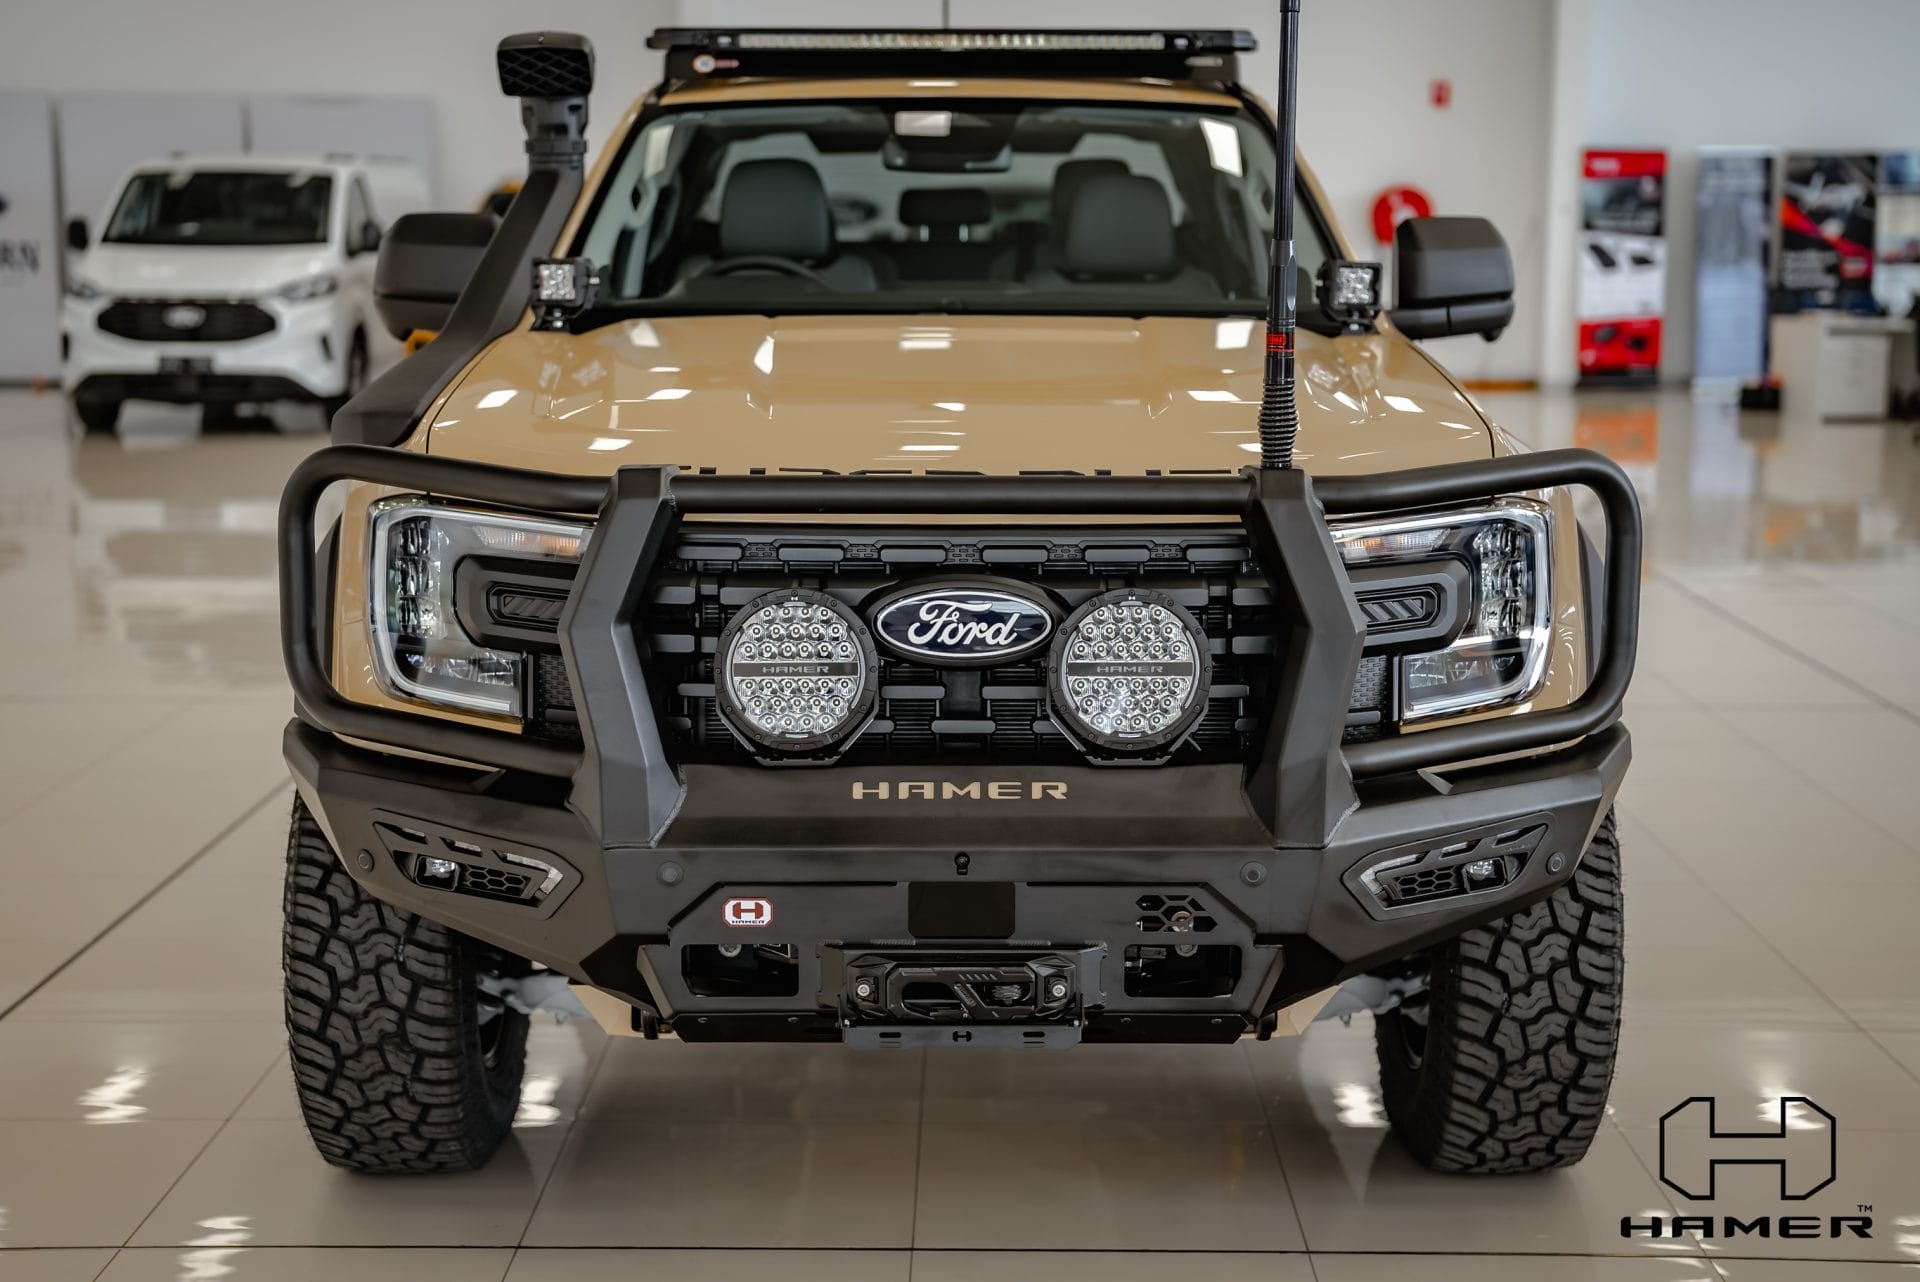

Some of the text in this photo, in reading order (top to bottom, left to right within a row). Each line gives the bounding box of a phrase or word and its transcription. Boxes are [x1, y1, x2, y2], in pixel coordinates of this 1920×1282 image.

[907, 600, 1020, 646] Ford
[762, 665, 830, 674] HAMER
[1096, 665, 1164, 673] HAMER
[852, 781, 1068, 800] HAMER
